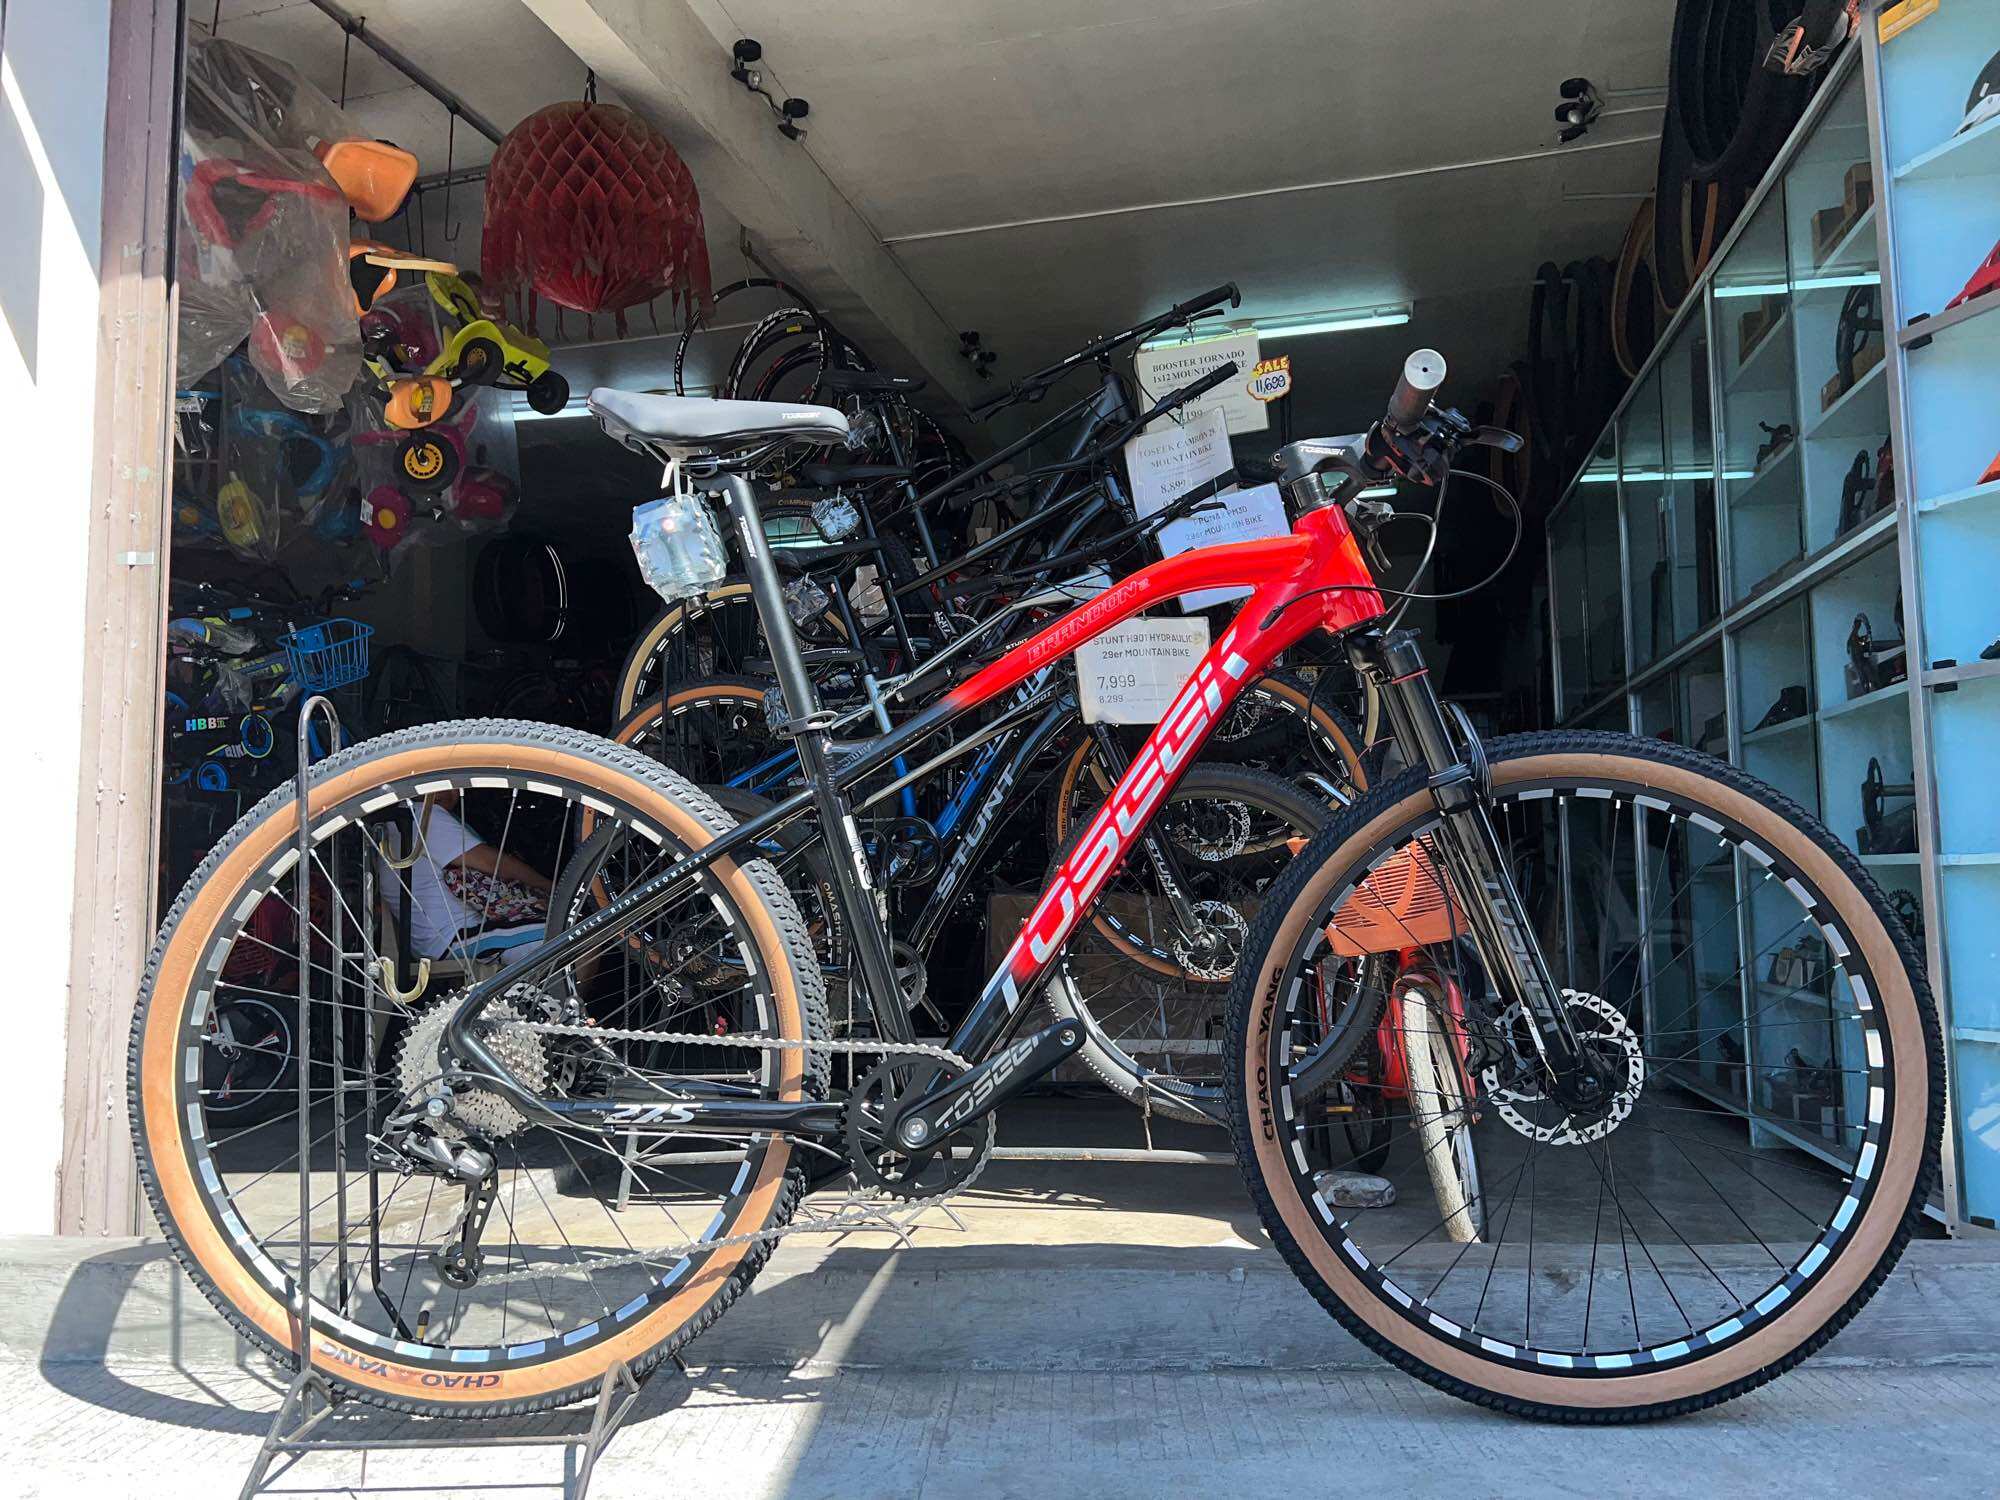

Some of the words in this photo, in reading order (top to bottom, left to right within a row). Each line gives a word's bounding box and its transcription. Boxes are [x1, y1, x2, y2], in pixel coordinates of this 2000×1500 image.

[1152, 356, 1195, 373] BOOSTER
[1199, 350, 1246, 366] TORNADO
[1255, 355, 1289, 377] SALE
[1153, 372, 1171, 384] 1x12
[1256, 375, 1286, 394] 11,699
[1151, 450, 1197, 469] MOUNTAIN
[1245, 514, 1264, 525] BIKE
[1026, 580, 1137, 665] BRANDON
[1093, 634, 1124, 646] STUNT
[1127, 633, 1148, 644] H901
[1150, 632, 1193, 644] HYDRAULIC
[1102, 650, 1122, 660] 29er
[1124, 649, 1171, 659] MOUNTAIN
[1172, 648, 1191, 658] BIKE
[1097, 674, 1136, 690] 7,999
[1099, 694, 1124, 705] 8,299
[982, 625, 1250, 1014] TOSEEK
[936, 762, 1015, 901] STUNT
[1148, 837, 1182, 899] STUNT
[567, 914, 603, 942] AGILE
[609, 894, 639, 914] RIDE
[646, 851, 709, 893] GEOMETRY
[1259, 967, 1284, 1035] YANG
[603, 1103, 704, 1124] 27.5
[1256, 1066, 1276, 1142] CHAO
[319, 1341, 388, 1377] YANG
[421, 1373, 501, 1389] CHAO
